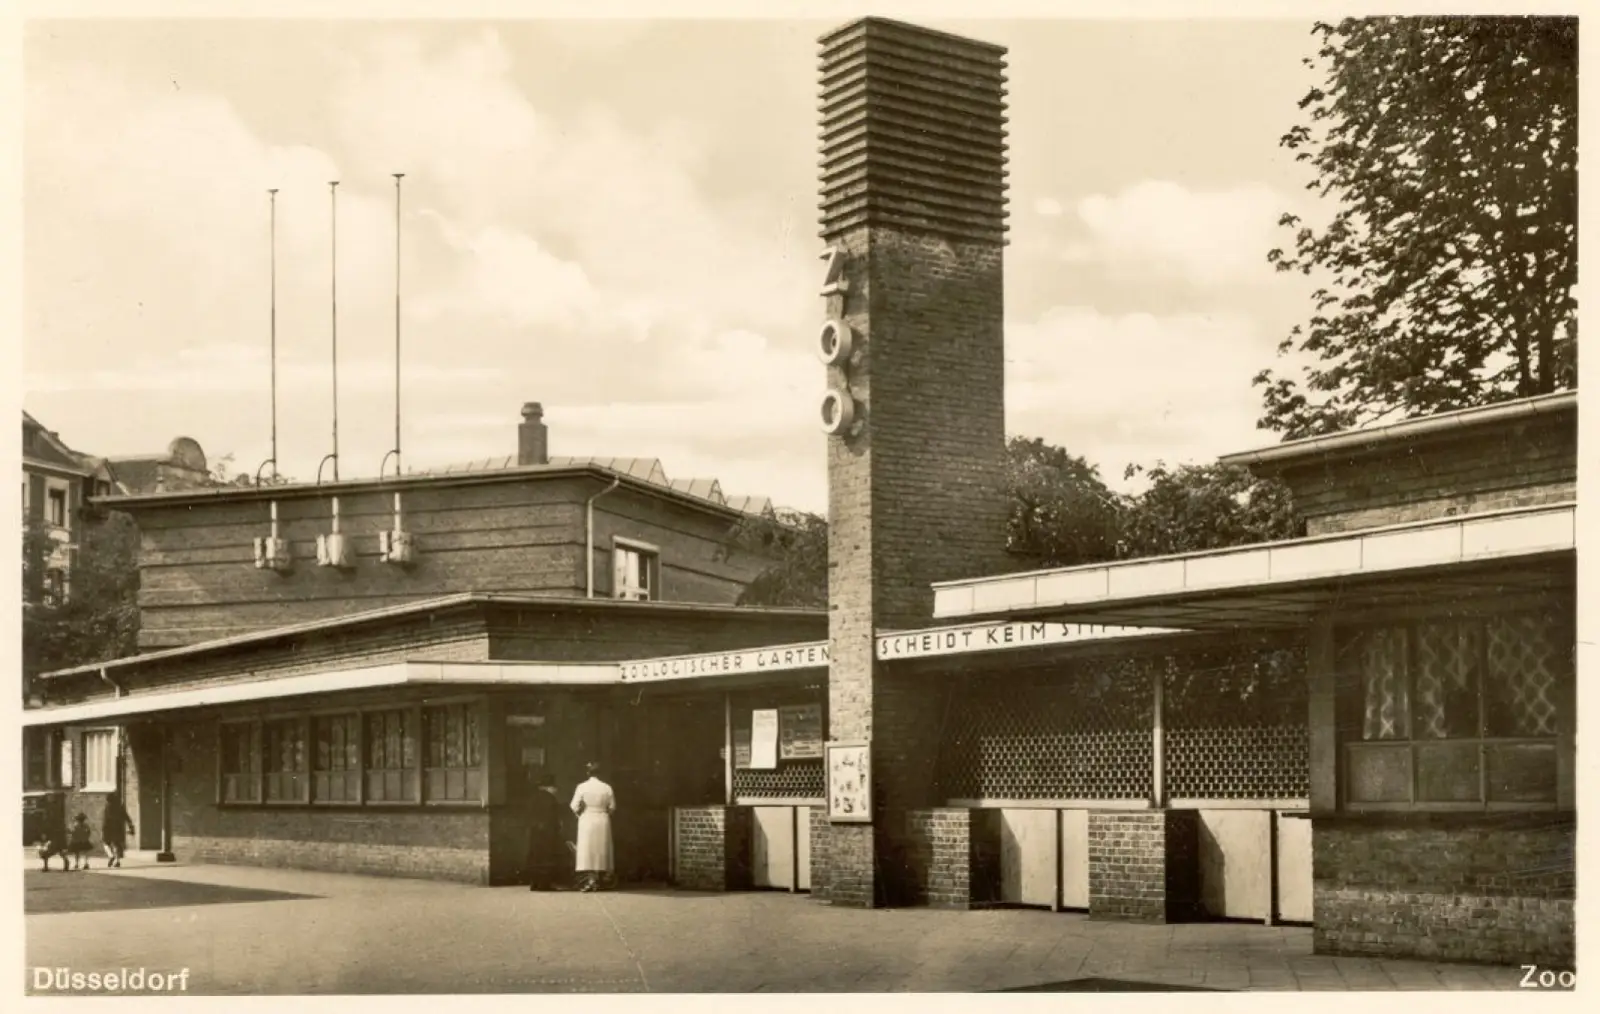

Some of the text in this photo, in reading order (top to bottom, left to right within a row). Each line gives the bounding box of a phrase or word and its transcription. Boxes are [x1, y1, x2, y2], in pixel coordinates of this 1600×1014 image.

[818, 246, 853, 435] ZOO
[882, 631, 972, 655] SCHEIDT
[987, 622, 1045, 644] KEIM
[620, 647, 830, 680] ZOOLOGISCHER GARTEN
